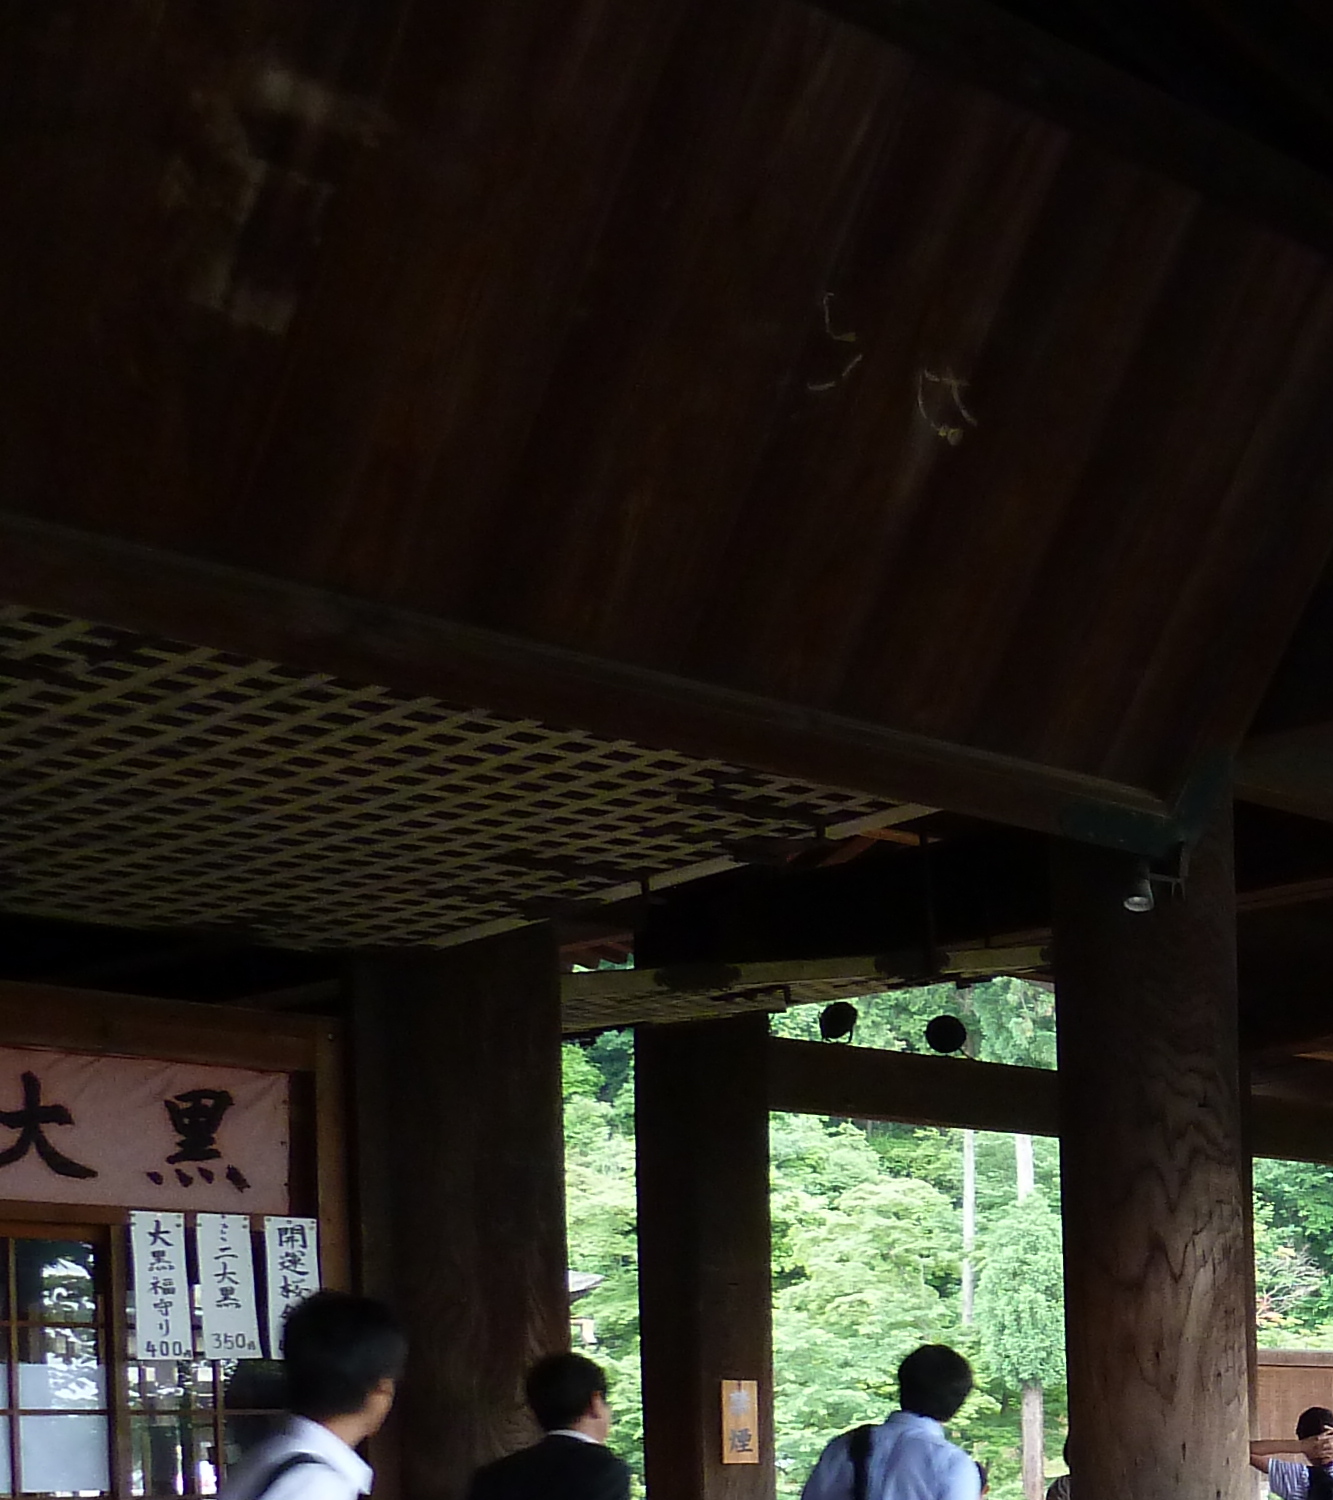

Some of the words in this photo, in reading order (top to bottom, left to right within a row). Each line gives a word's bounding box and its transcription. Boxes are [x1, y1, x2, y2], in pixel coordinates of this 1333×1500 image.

[0, 1070, 251, 1193] 大黒
[146, 1219, 177, 1337] 大黒福守り
